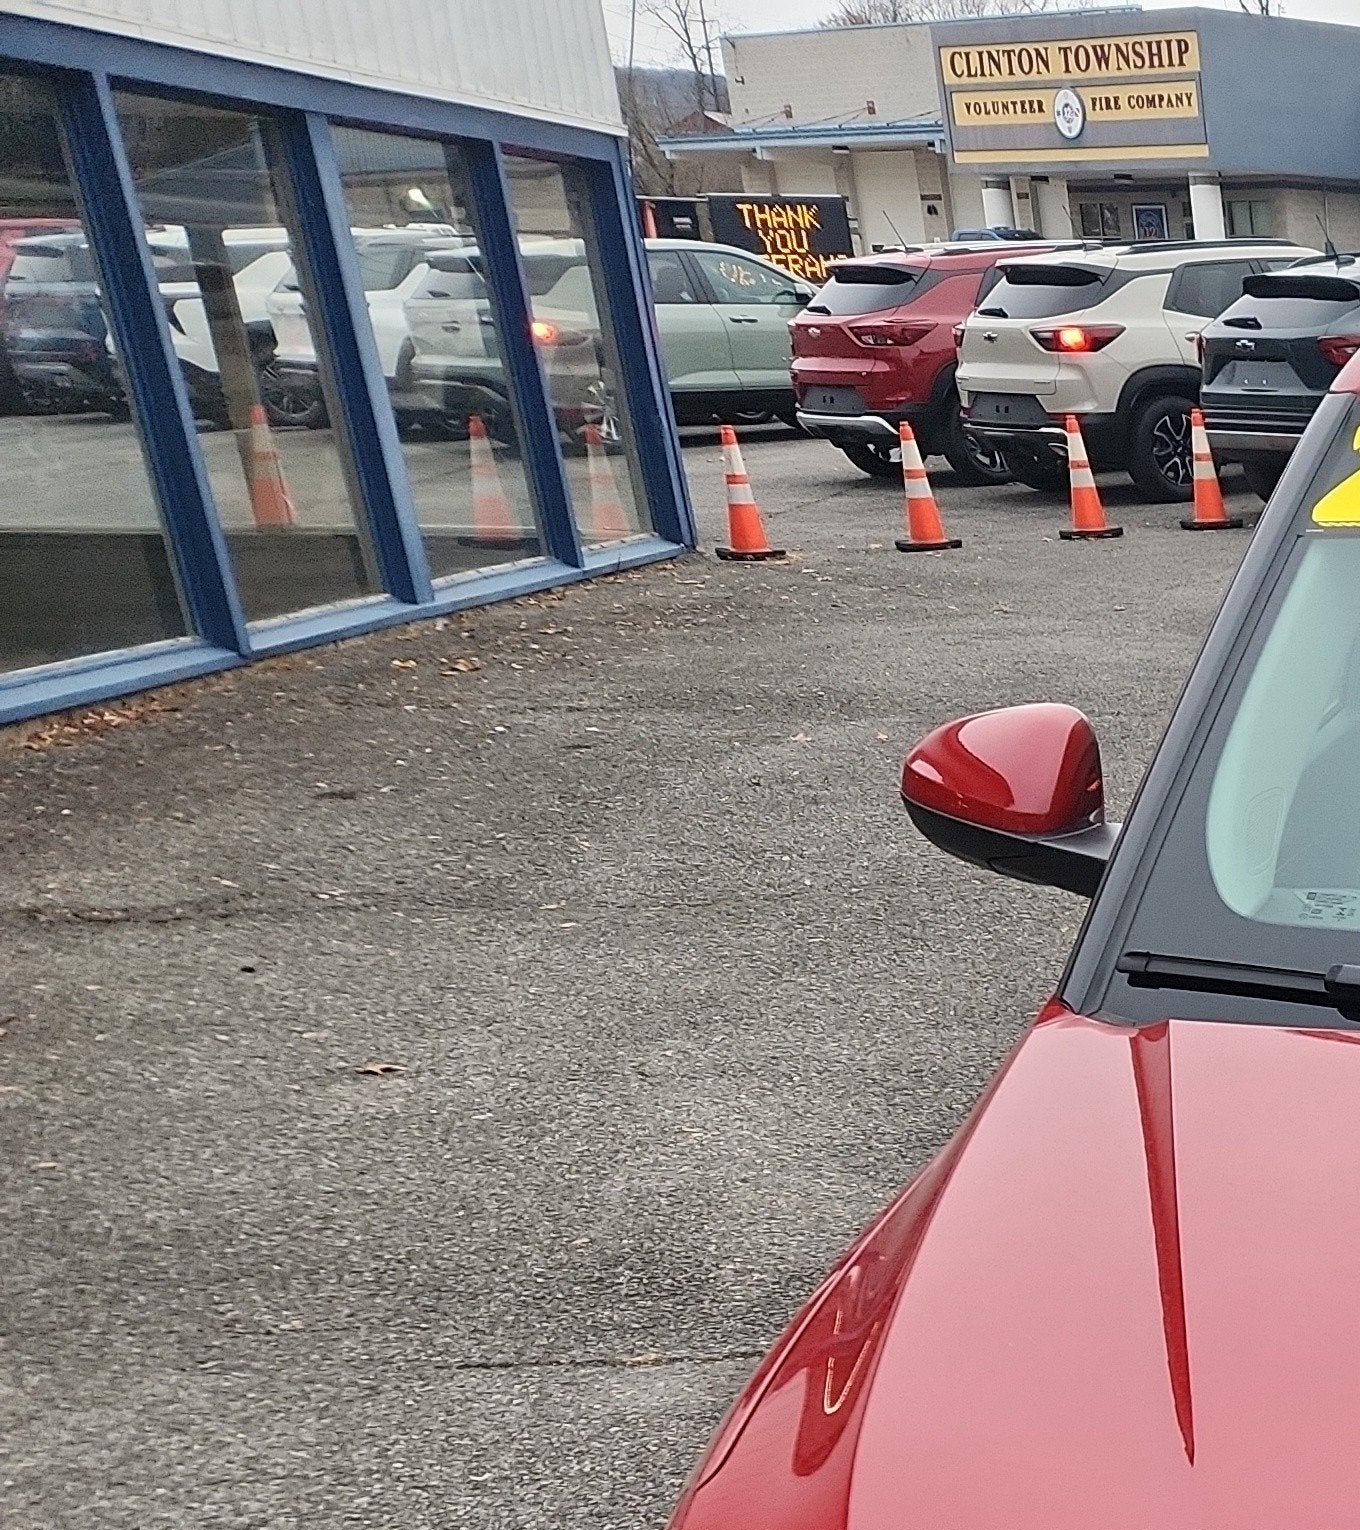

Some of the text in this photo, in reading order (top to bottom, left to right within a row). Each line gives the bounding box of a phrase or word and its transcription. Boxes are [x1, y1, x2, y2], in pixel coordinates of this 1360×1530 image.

[949, 38, 1190, 78] CLINTON TOWNSHIP
[964, 92, 1193, 116] VOLUNTEER FIRE COMPANY
[735, 203, 823, 231] THANK
[758, 229, 809, 254] YOU
